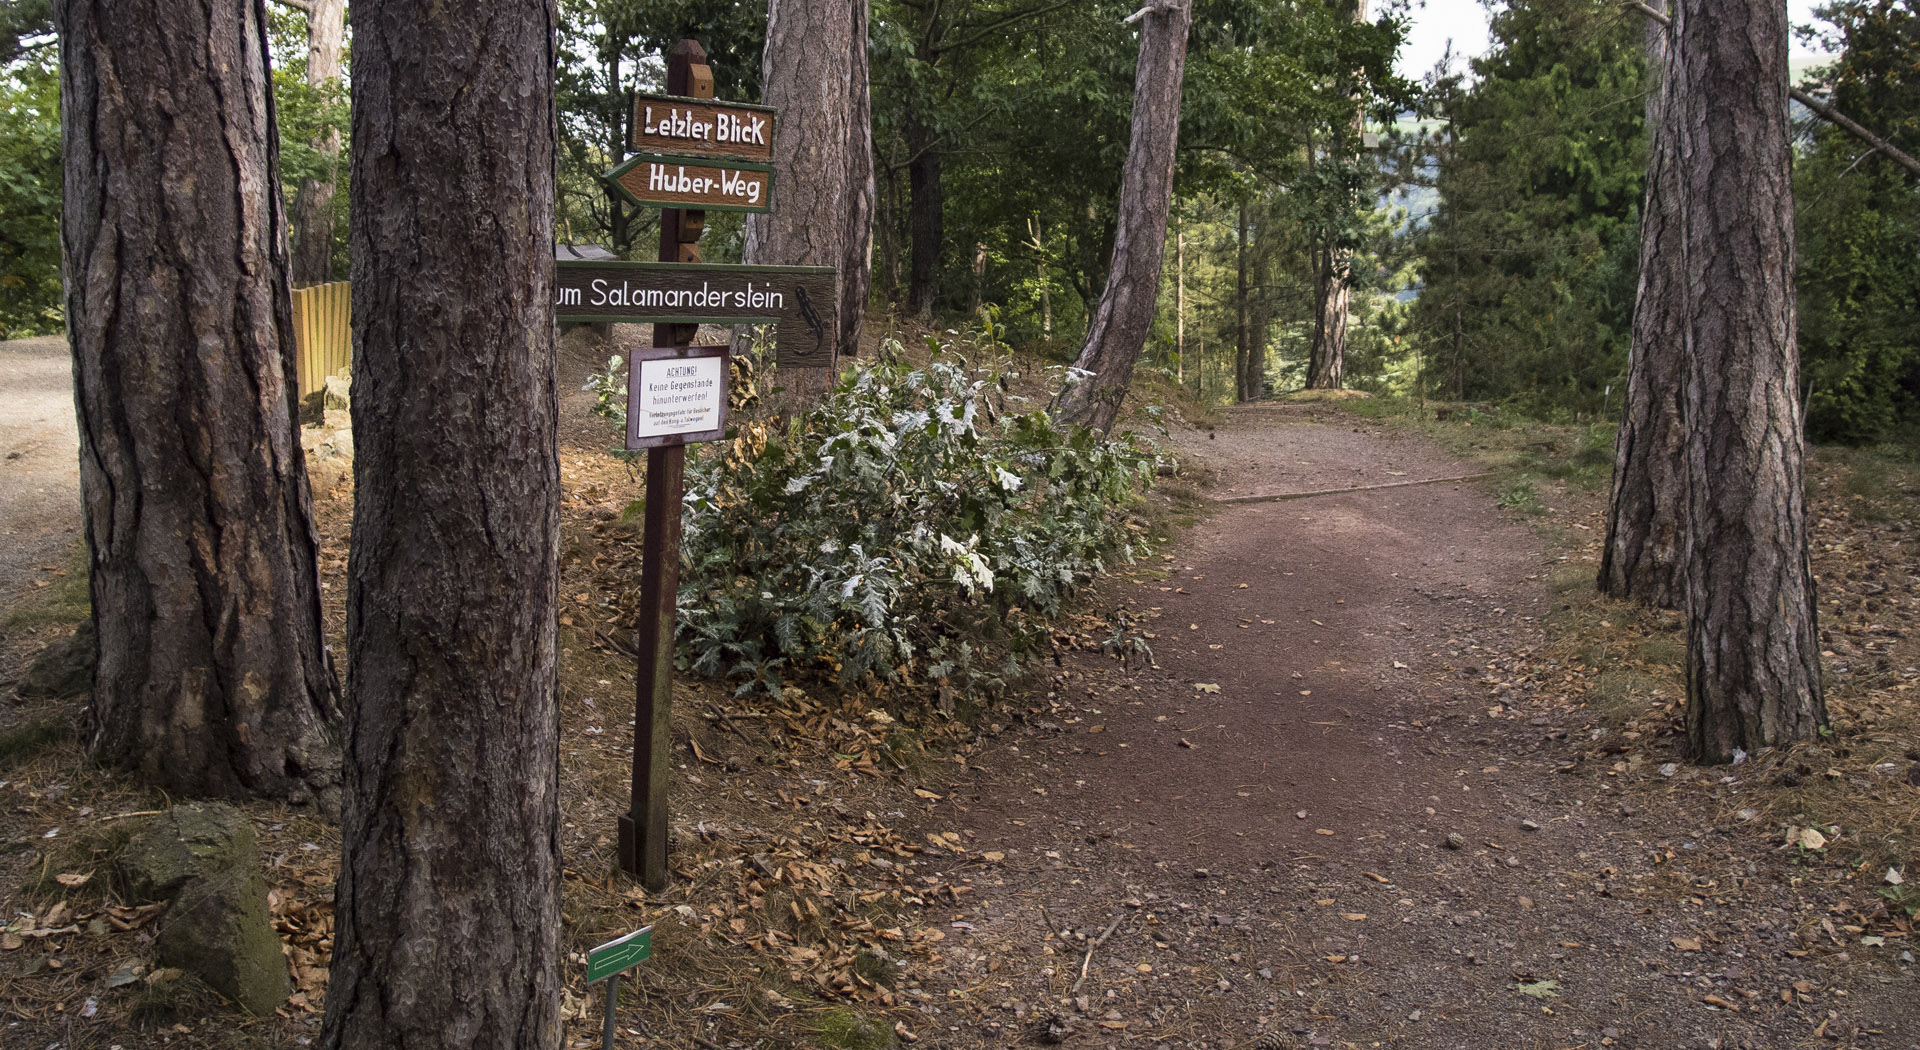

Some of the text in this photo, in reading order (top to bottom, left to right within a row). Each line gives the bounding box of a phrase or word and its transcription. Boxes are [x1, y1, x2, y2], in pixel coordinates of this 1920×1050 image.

[644, 106, 713, 140] Letzter
[649, 163, 761, 204] Huber-Weg
[590, 278, 783, 308] Salamanderstein
[666, 365, 698, 377] ACHTUNG!
[649, 378, 713, 392] Keine Gegenstände
[652, 391, 708, 405] hinunterwerfen!
